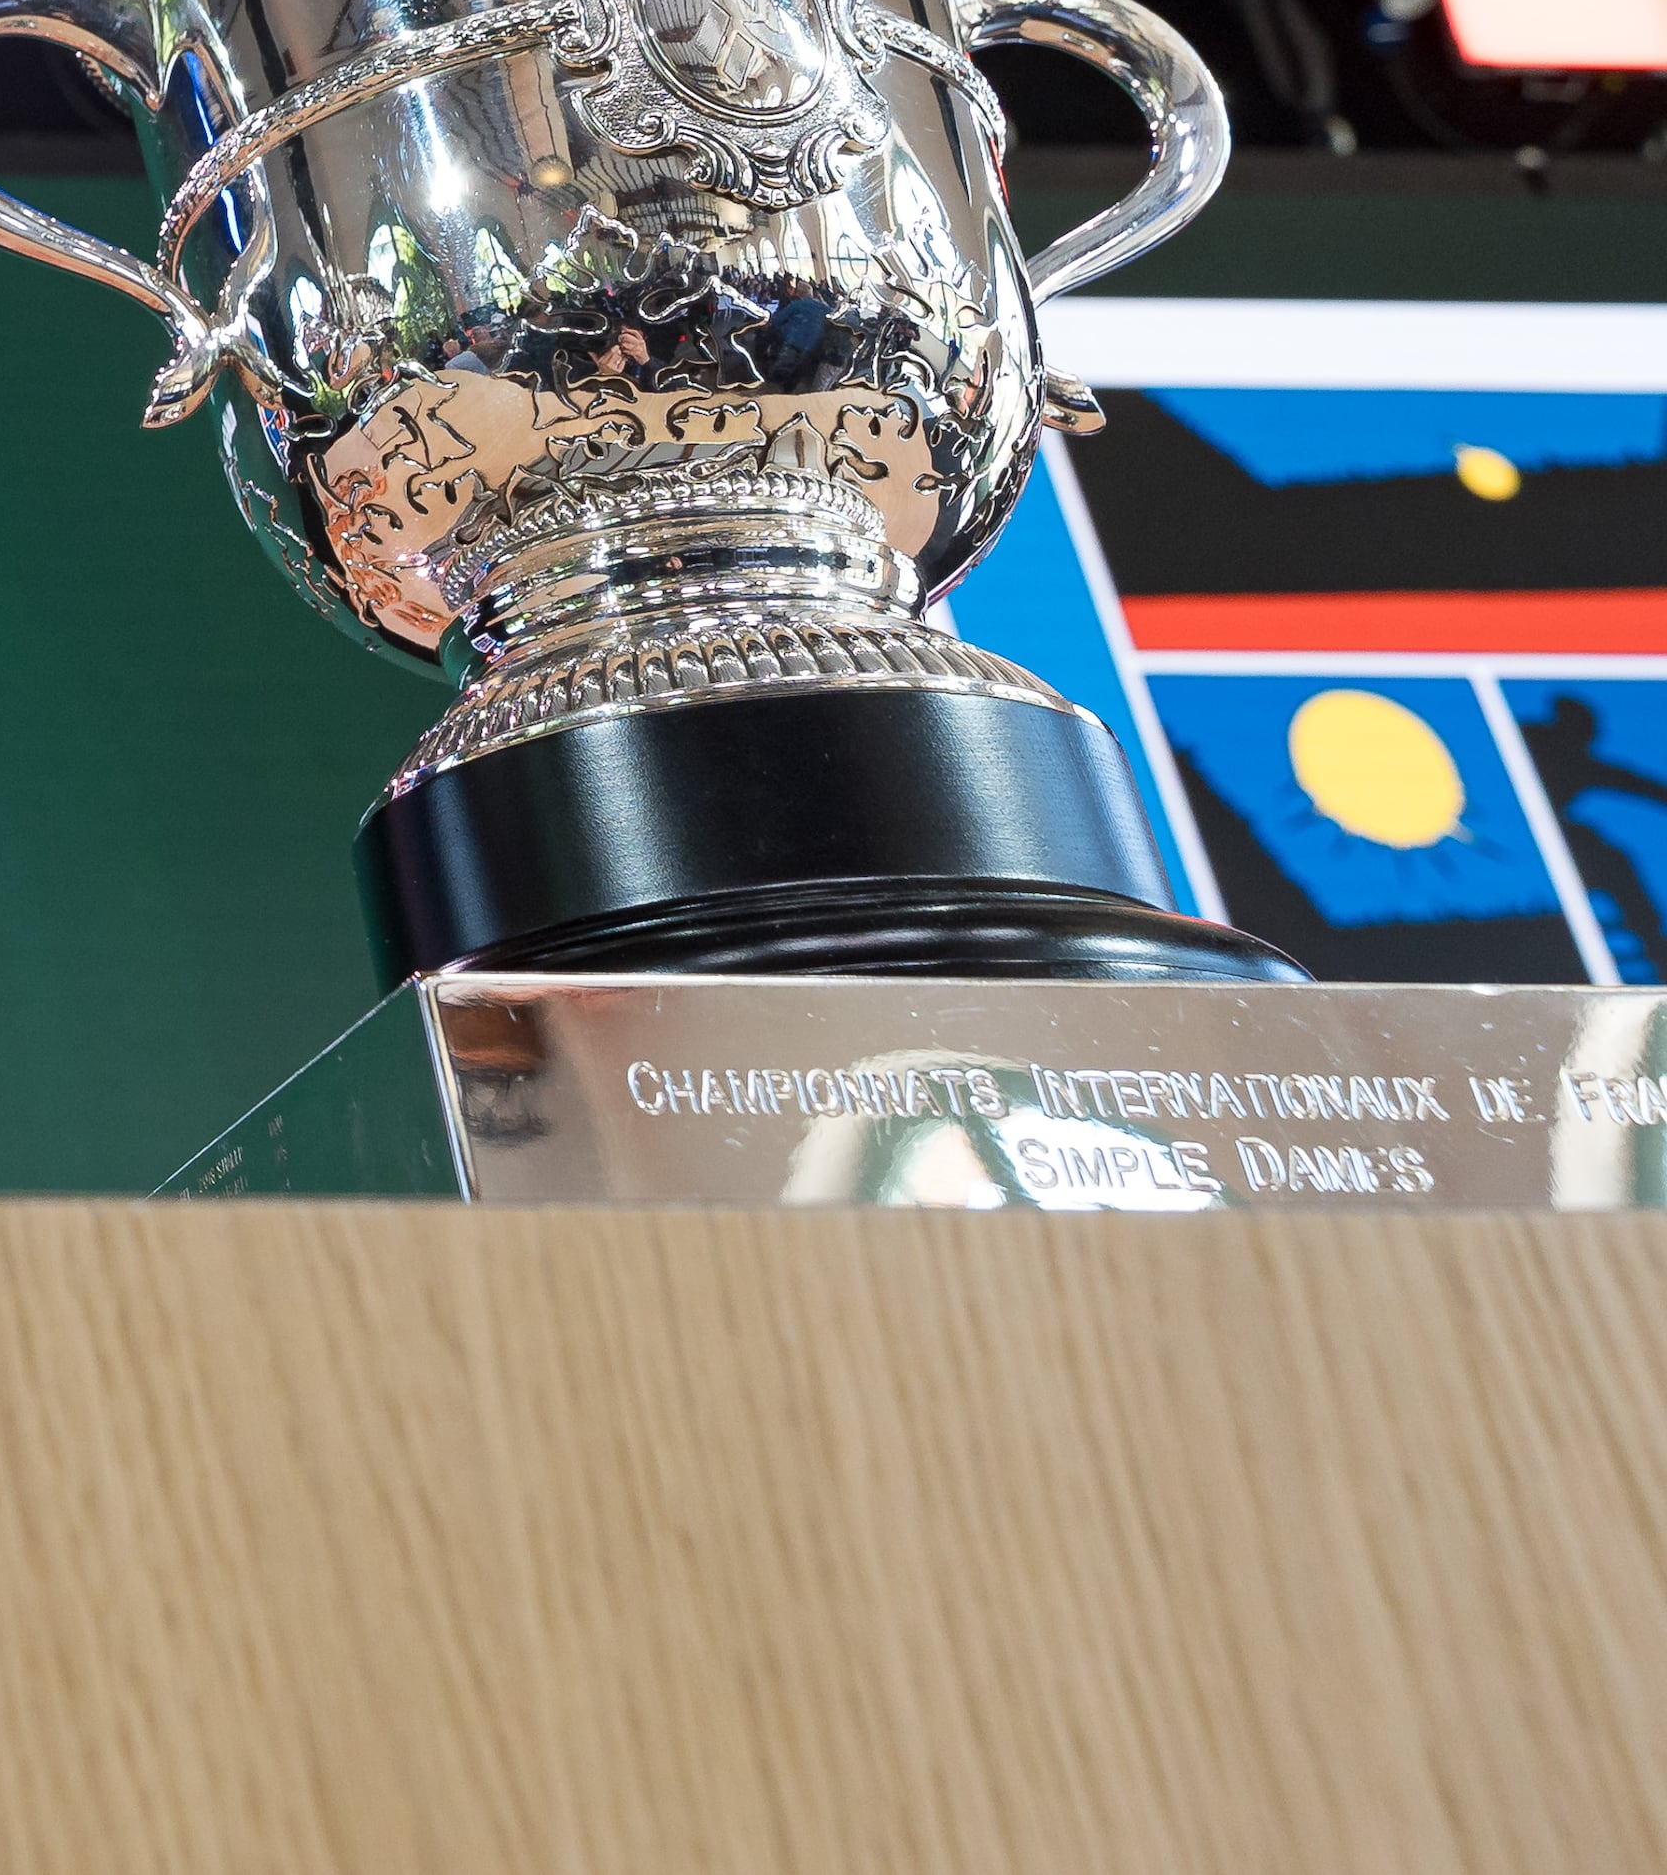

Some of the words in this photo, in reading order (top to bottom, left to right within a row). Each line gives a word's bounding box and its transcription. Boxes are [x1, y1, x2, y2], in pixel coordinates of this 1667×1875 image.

[1468, 1076, 1547, 1124] DE
[1558, 1066, 1667, 1126] FRA
[1016, 1136, 1224, 1192] SIMPLE
[1234, 1135, 1435, 1194] DAMES
